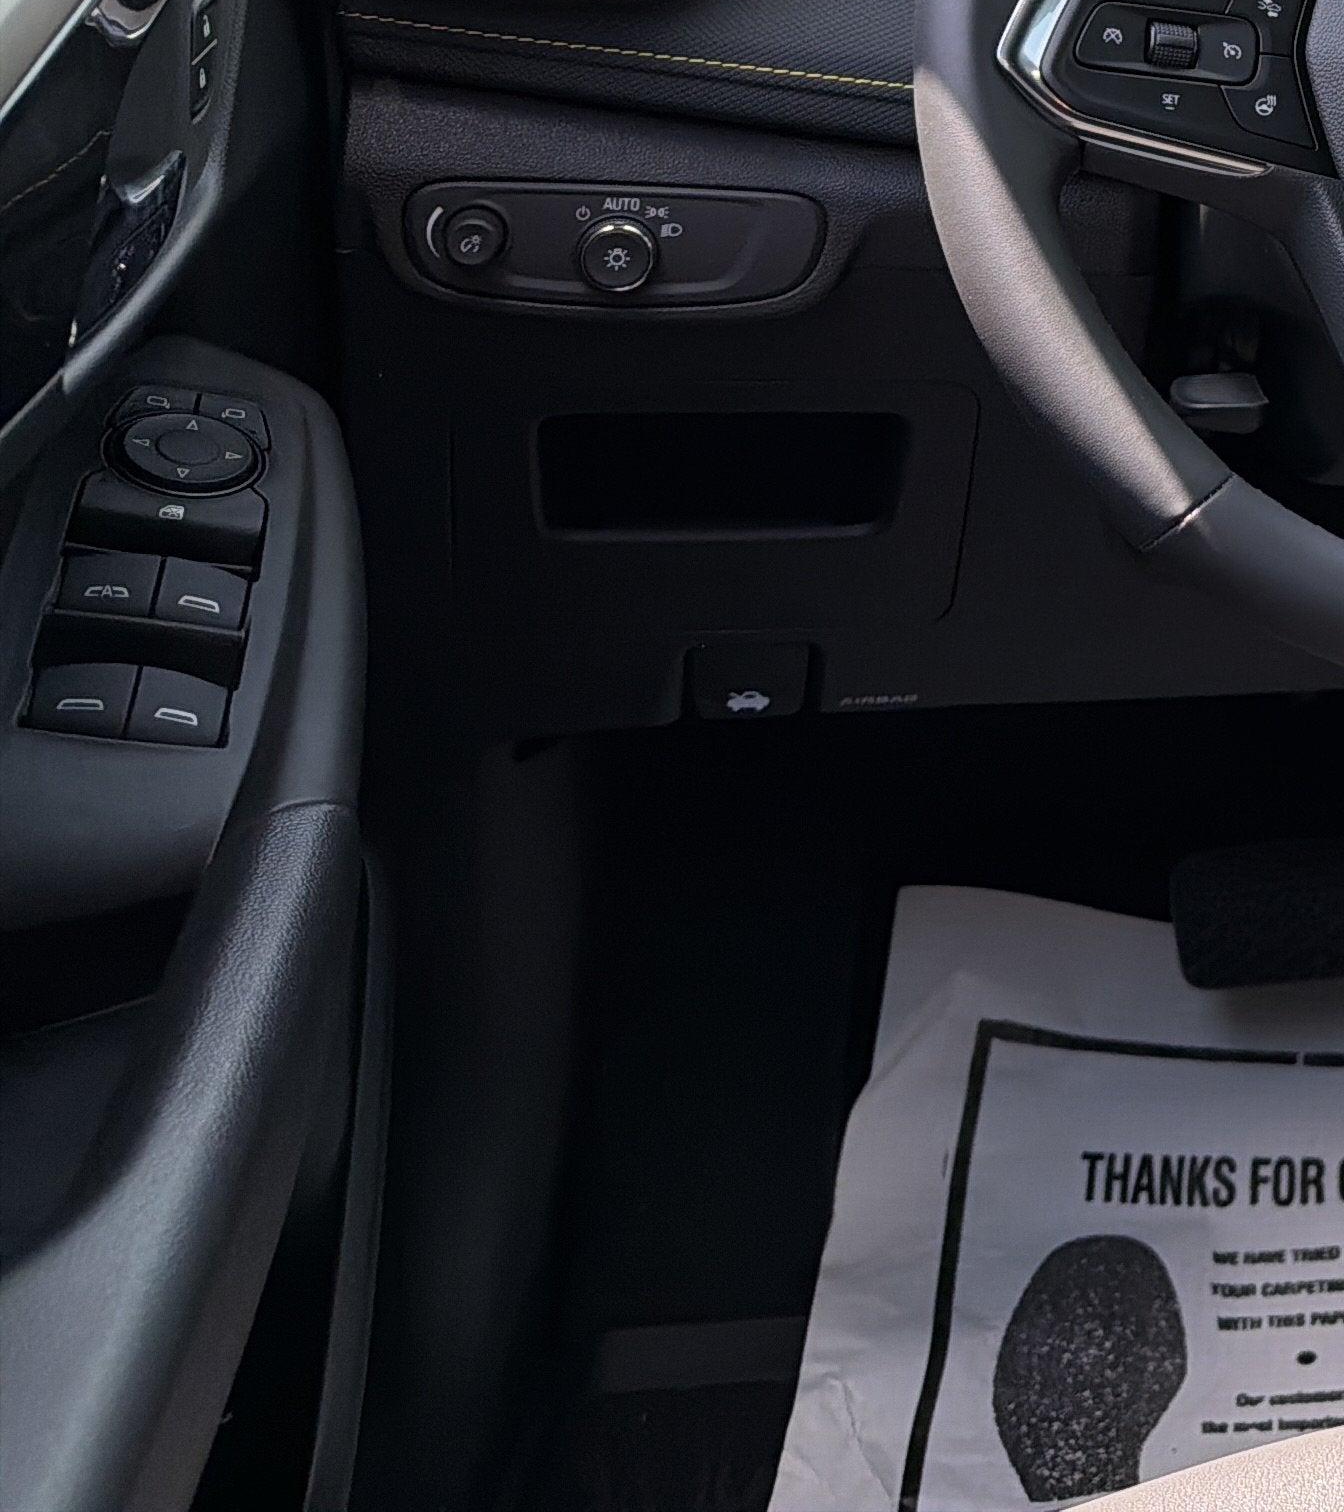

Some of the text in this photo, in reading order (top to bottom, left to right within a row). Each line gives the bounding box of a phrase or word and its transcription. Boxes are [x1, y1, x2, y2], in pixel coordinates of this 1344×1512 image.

[1161, 93, 1180, 105] SET
[602, 197, 640, 211] AUTO
[1081, 1150, 1238, 1208] THANKS
[1249, 1154, 1326, 1208] FOR
[1212, 1248, 1239, 1266] WE
[1243, 1248, 1286, 1265] HAVE
[1291, 1244, 1341, 1263] TRIED
[1210, 1281, 1258, 1299] YOUR
[1216, 1314, 1263, 1332] WITH
[1267, 1312, 1305, 1329] THIS
[1236, 1392, 1265, 1407] Our
